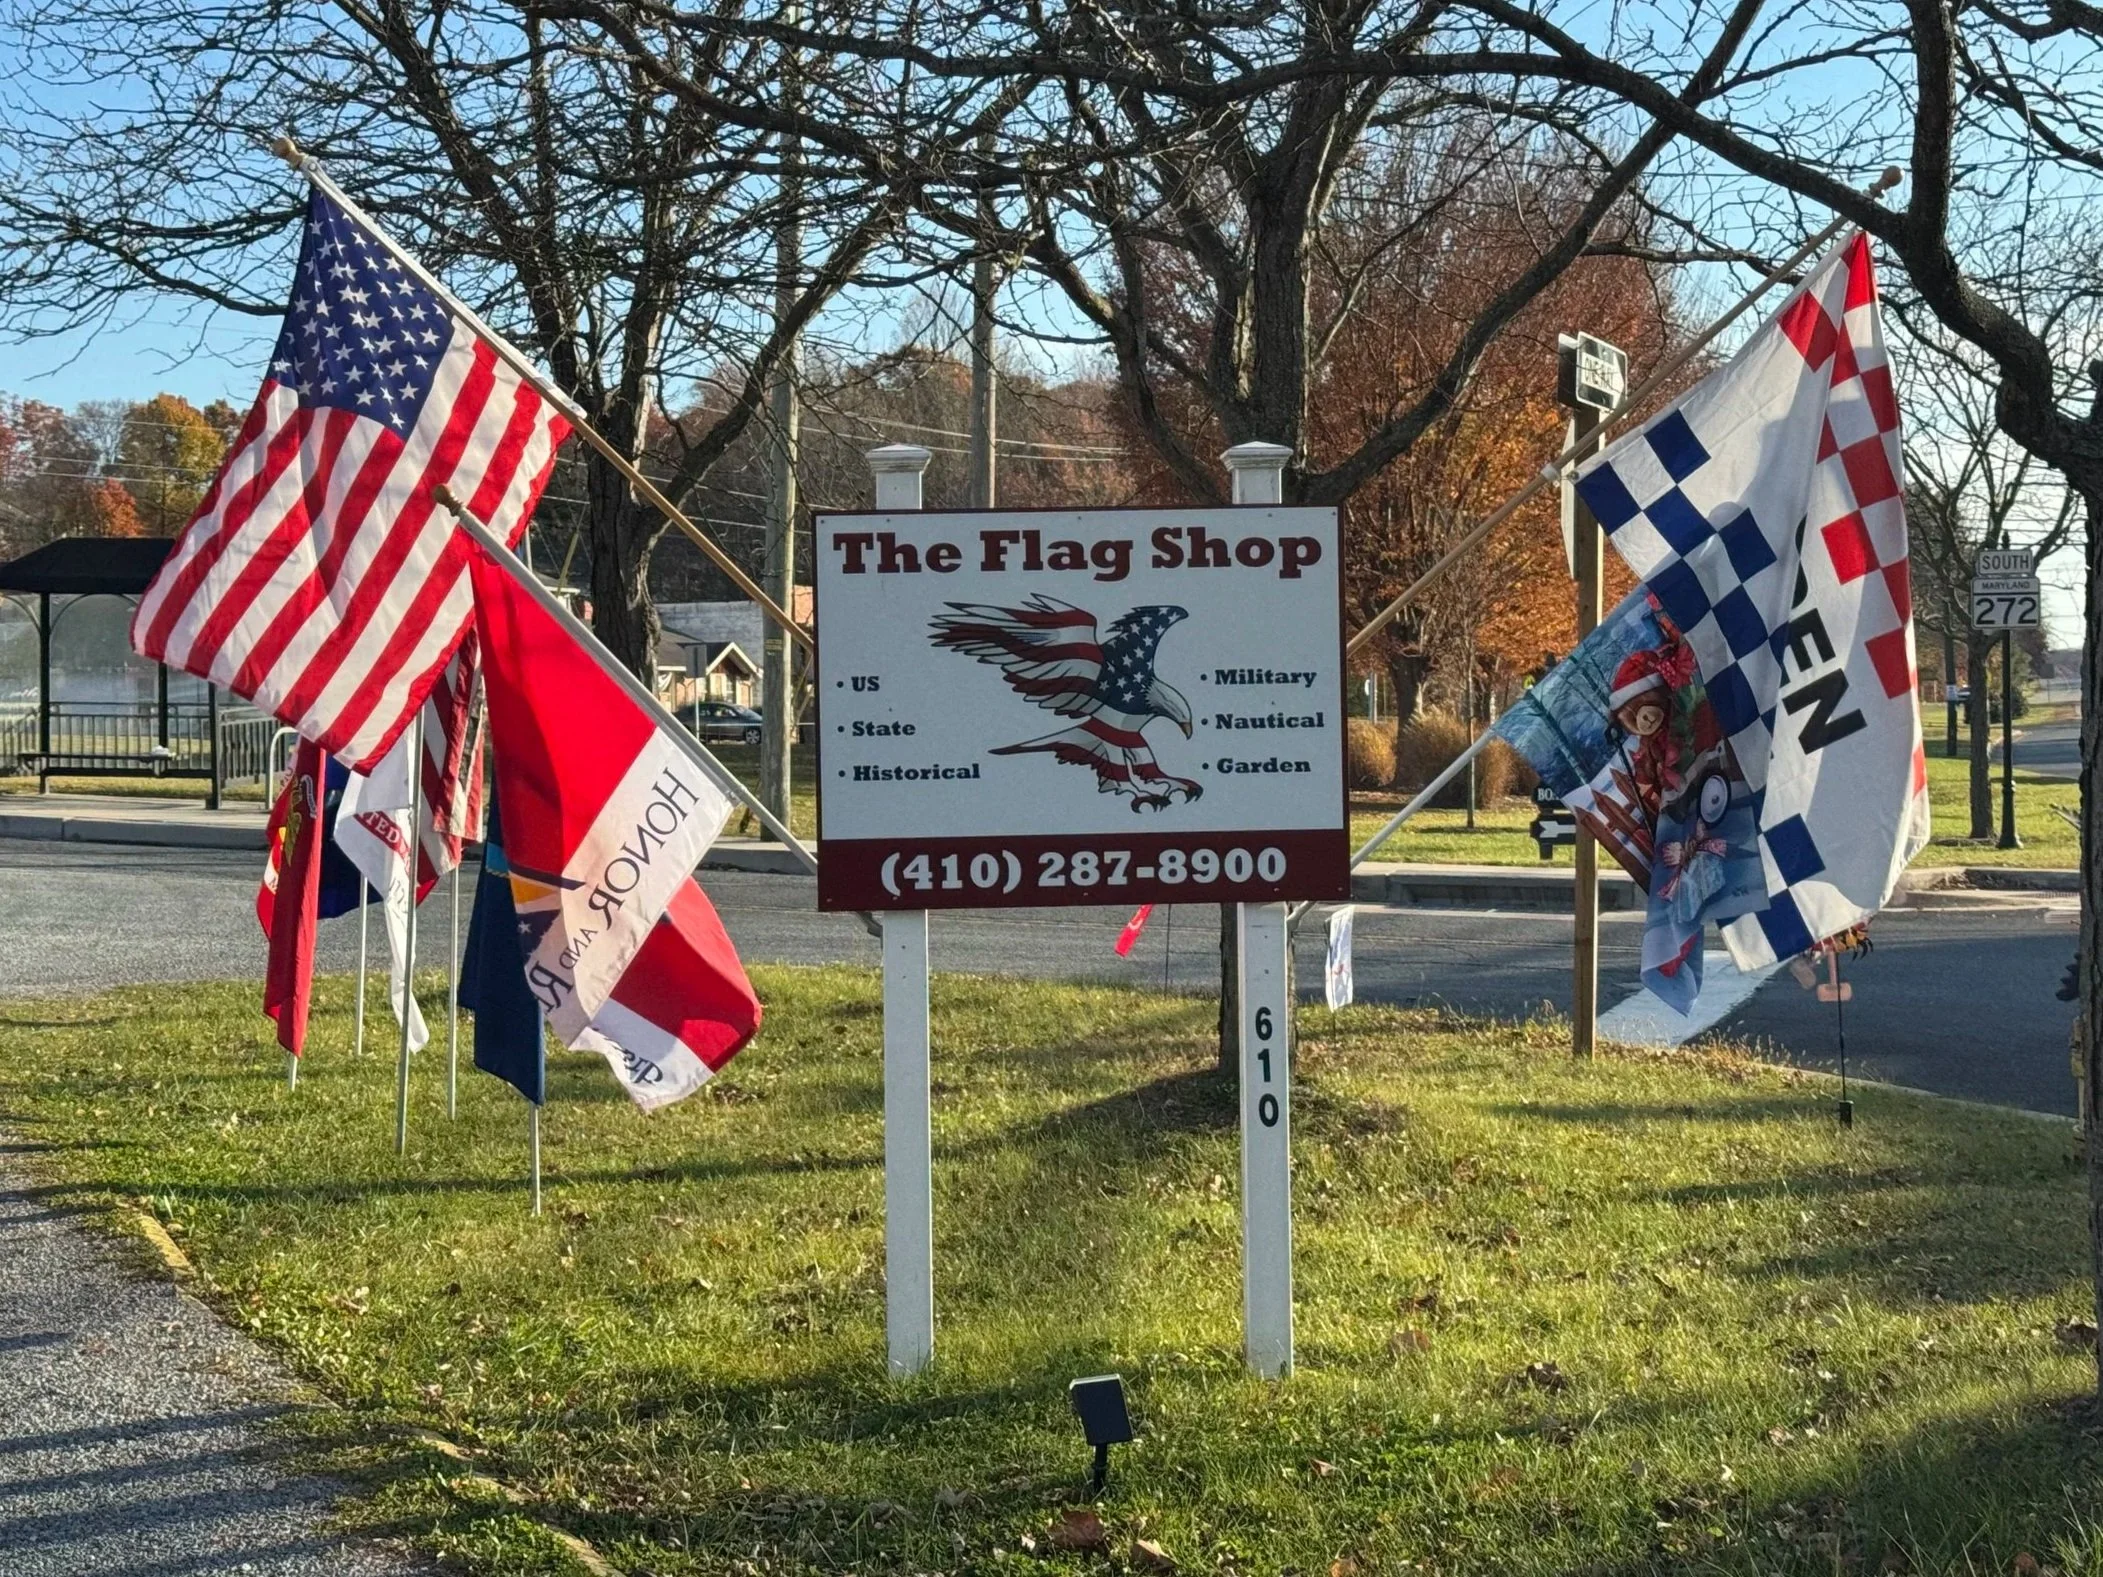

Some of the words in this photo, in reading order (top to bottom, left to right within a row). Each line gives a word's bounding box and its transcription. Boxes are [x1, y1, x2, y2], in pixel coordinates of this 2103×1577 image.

[832, 532, 963, 574] The
[980, 529, 1134, 582] Flag
[1151, 526, 1322, 579] Shop
[1982, 554, 2030, 570] SOUTH
[1982, 581, 2031, 590] MARYLAND
[1975, 596, 2037, 625] 272
[851, 675, 880, 693] US
[1214, 668, 1318, 689] Military
[852, 720, 916, 737] State
[1215, 711, 1325, 730] Nautical
[853, 762, 981, 782] Historical
[1216, 757, 1312, 775] Garden
[880, 849, 1022, 897] (410)
[1038, 847, 1287, 887] 287-8900
[1255, 1006, 1279, 1127] 610
